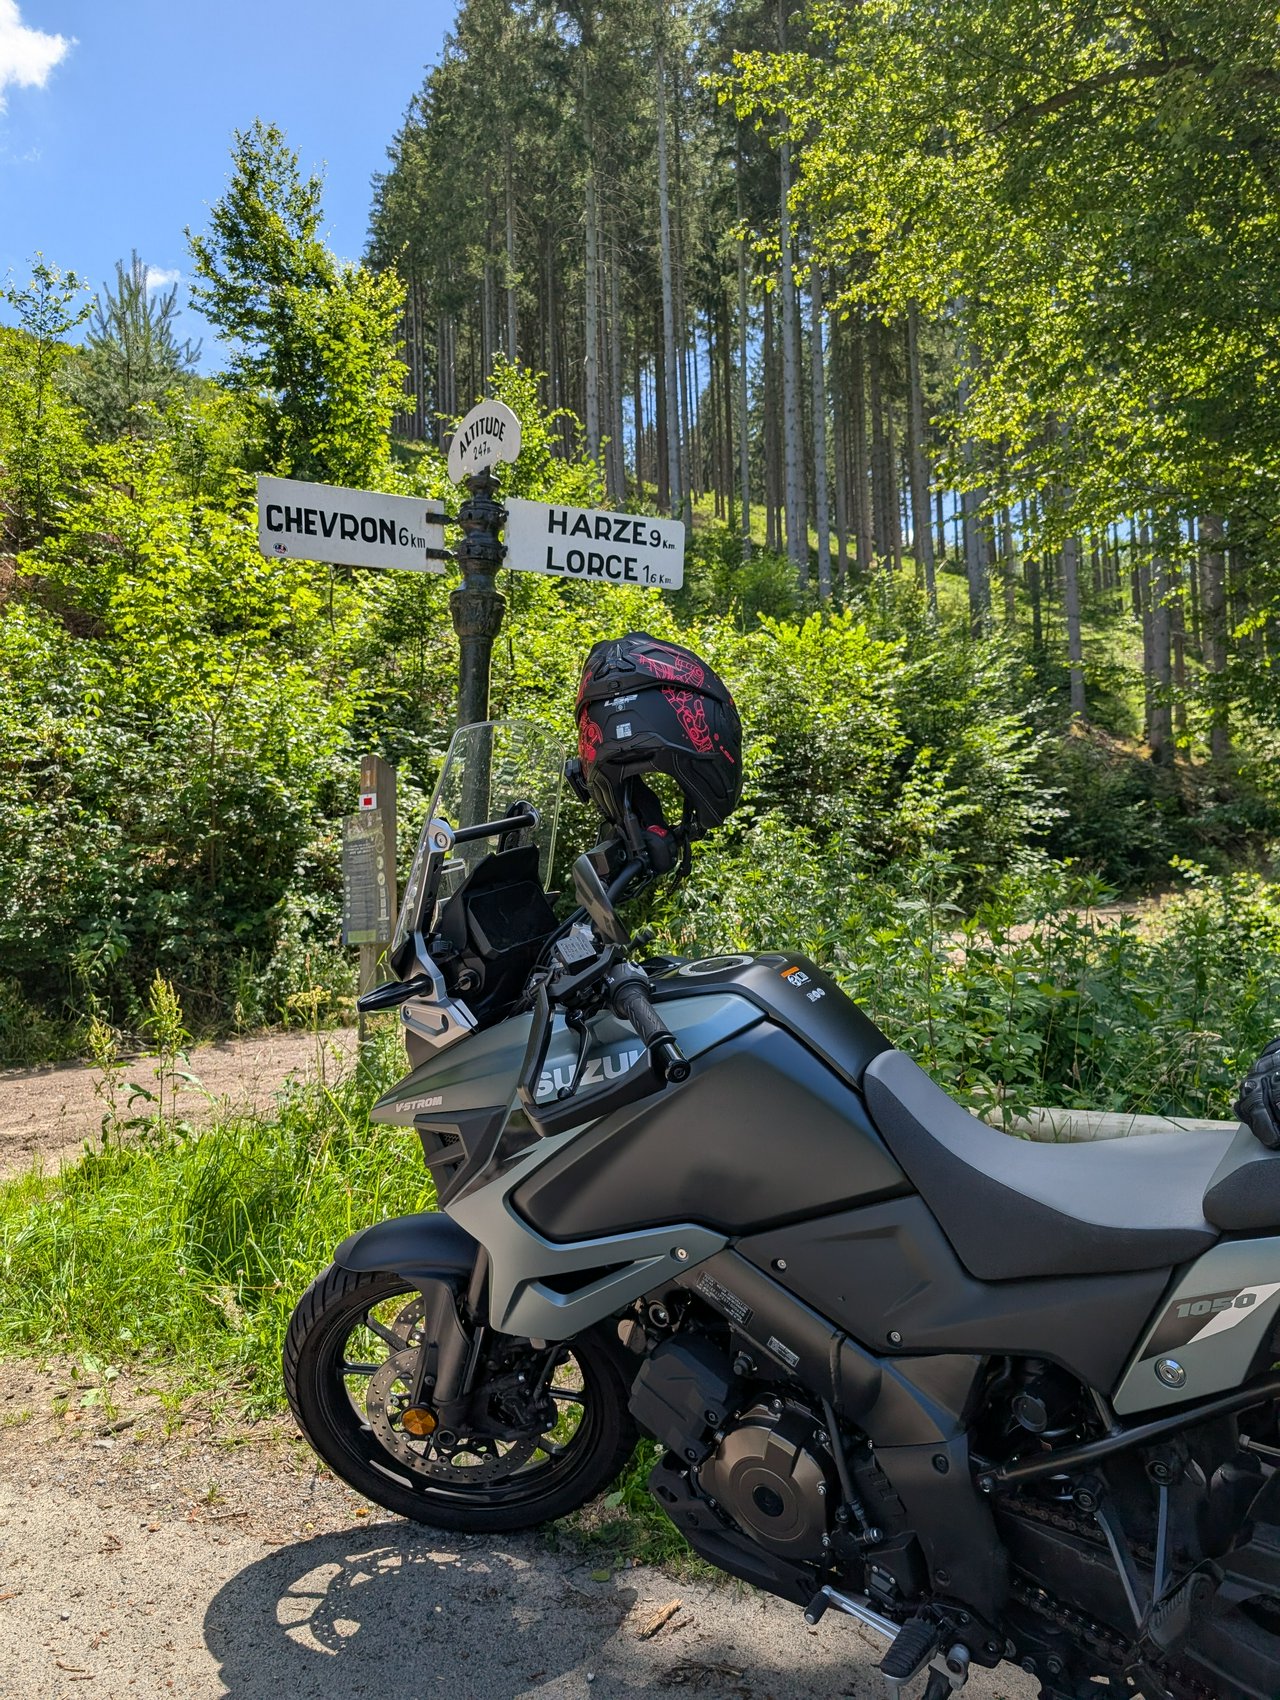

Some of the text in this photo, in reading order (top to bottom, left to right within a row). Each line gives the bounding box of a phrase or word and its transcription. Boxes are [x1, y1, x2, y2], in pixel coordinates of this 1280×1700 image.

[459, 416, 506, 460] ALTITUDE
[266, 504, 397, 546] CHEVRON
[548, 509, 647, 546] HARZE
[546, 546, 638, 581] LORCE
[535, 1050, 639, 1097] SUZU
[1176, 1293, 1257, 1318] 1050
